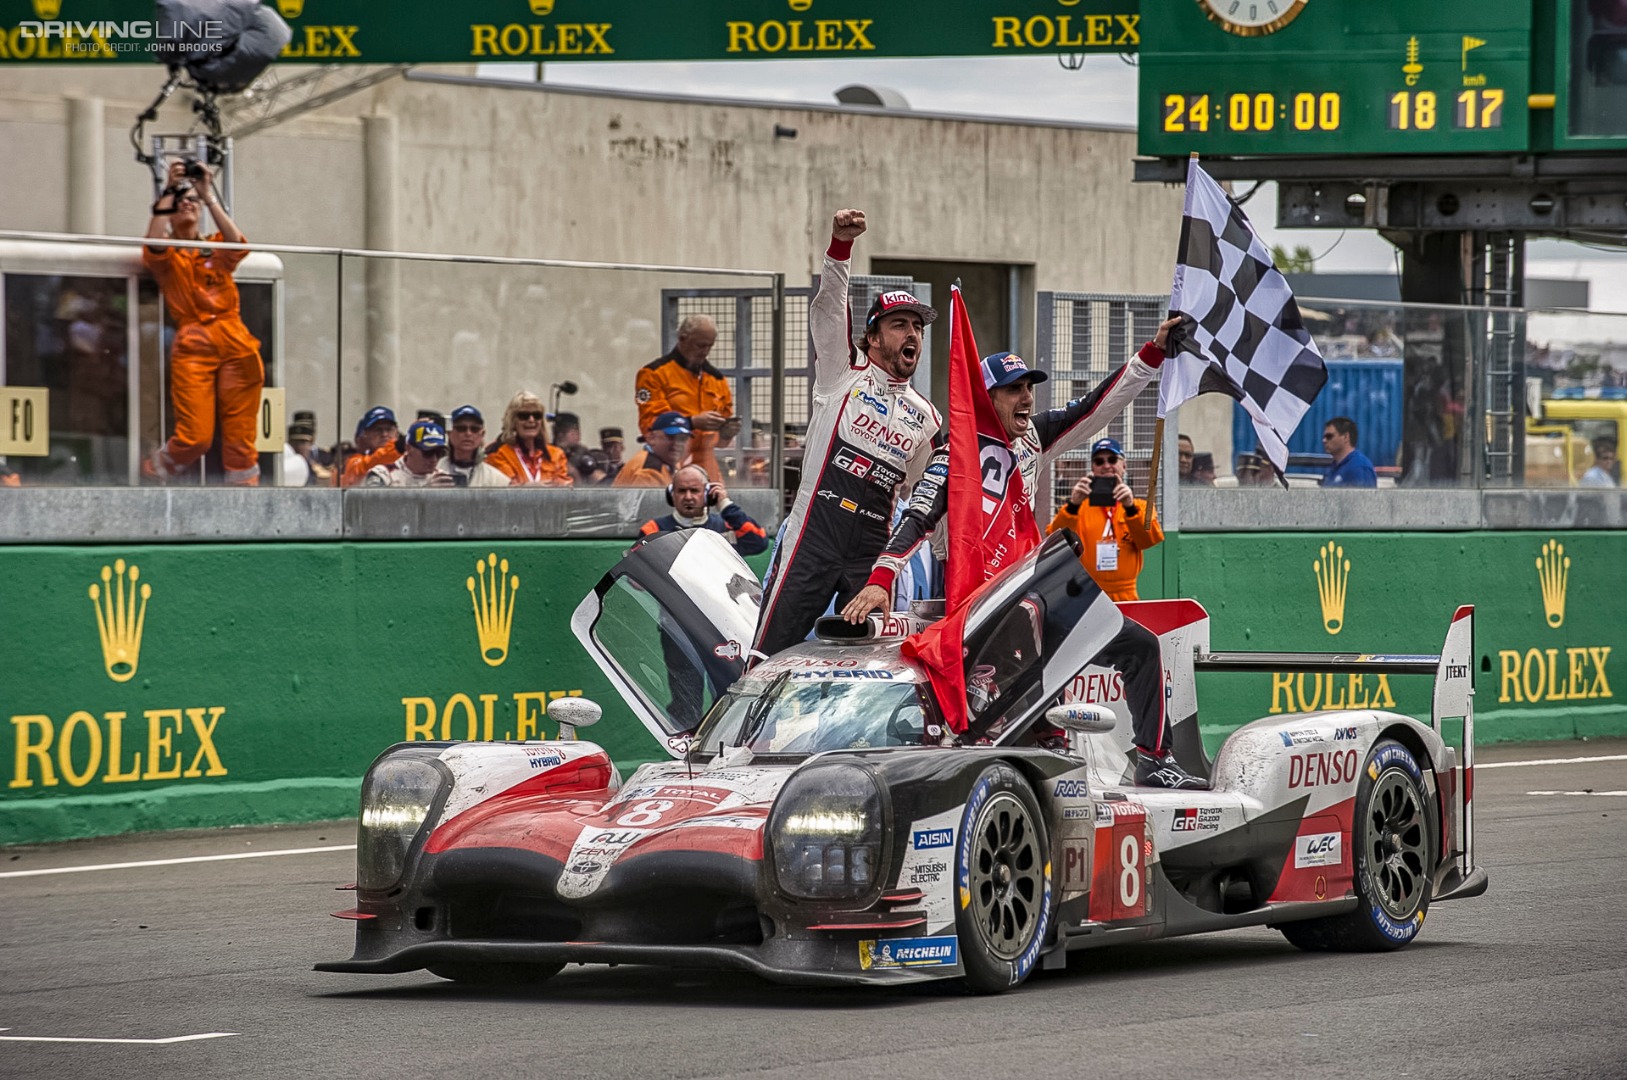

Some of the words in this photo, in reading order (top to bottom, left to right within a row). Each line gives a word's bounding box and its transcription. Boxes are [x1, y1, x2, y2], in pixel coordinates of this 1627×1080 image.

[470, 23, 614, 56] ROLEX
[726, 19, 876, 53] ROLEX
[992, 14, 1141, 48] ROLEX
[1164, 92, 1340, 133] 24:00:00
[1391, 91, 1436, 130] 18
[1457, 89, 1504, 129] 17
[850, 424, 878, 445] TOYOTA
[852, 412, 914, 452] DENSO
[834, 454, 867, 477] GR
[793, 669, 894, 680] HYBRID
[1445, 665, 1468, 682] JTEKT
[1498, 647, 1613, 704] ROLEX
[1072, 672, 1127, 704] DENS
[1269, 673, 1396, 714] ROLEX
[1068, 710, 1092, 721] Mobil
[9, 706, 228, 788] ROLEX
[1381, 748, 1418, 771] MICHELIN
[529, 756, 561, 769] HYBRID
[1288, 749, 1358, 789] DENSO
[663, 788, 721, 800] TOTAL
[1054, 780, 1088, 797] RAYS
[616, 800, 675, 827] 8
[1111, 801, 1145, 816] TOTAL
[1199, 807, 1222, 815] TOYOTA
[962, 784, 987, 868] MICHELIN
[1173, 816, 1196, 830] GR
[1197, 823, 1219, 831] Racing
[918, 831, 951, 847] AISIN
[1307, 836, 1336, 855] WEC
[1065, 846, 1085, 882] P1
[1120, 834, 1140, 907] 8
[1022, 897, 1050, 972] MICHELIN
[1376, 913, 1415, 938] MICHELIN
[895, 945, 952, 961] MICHELIN
